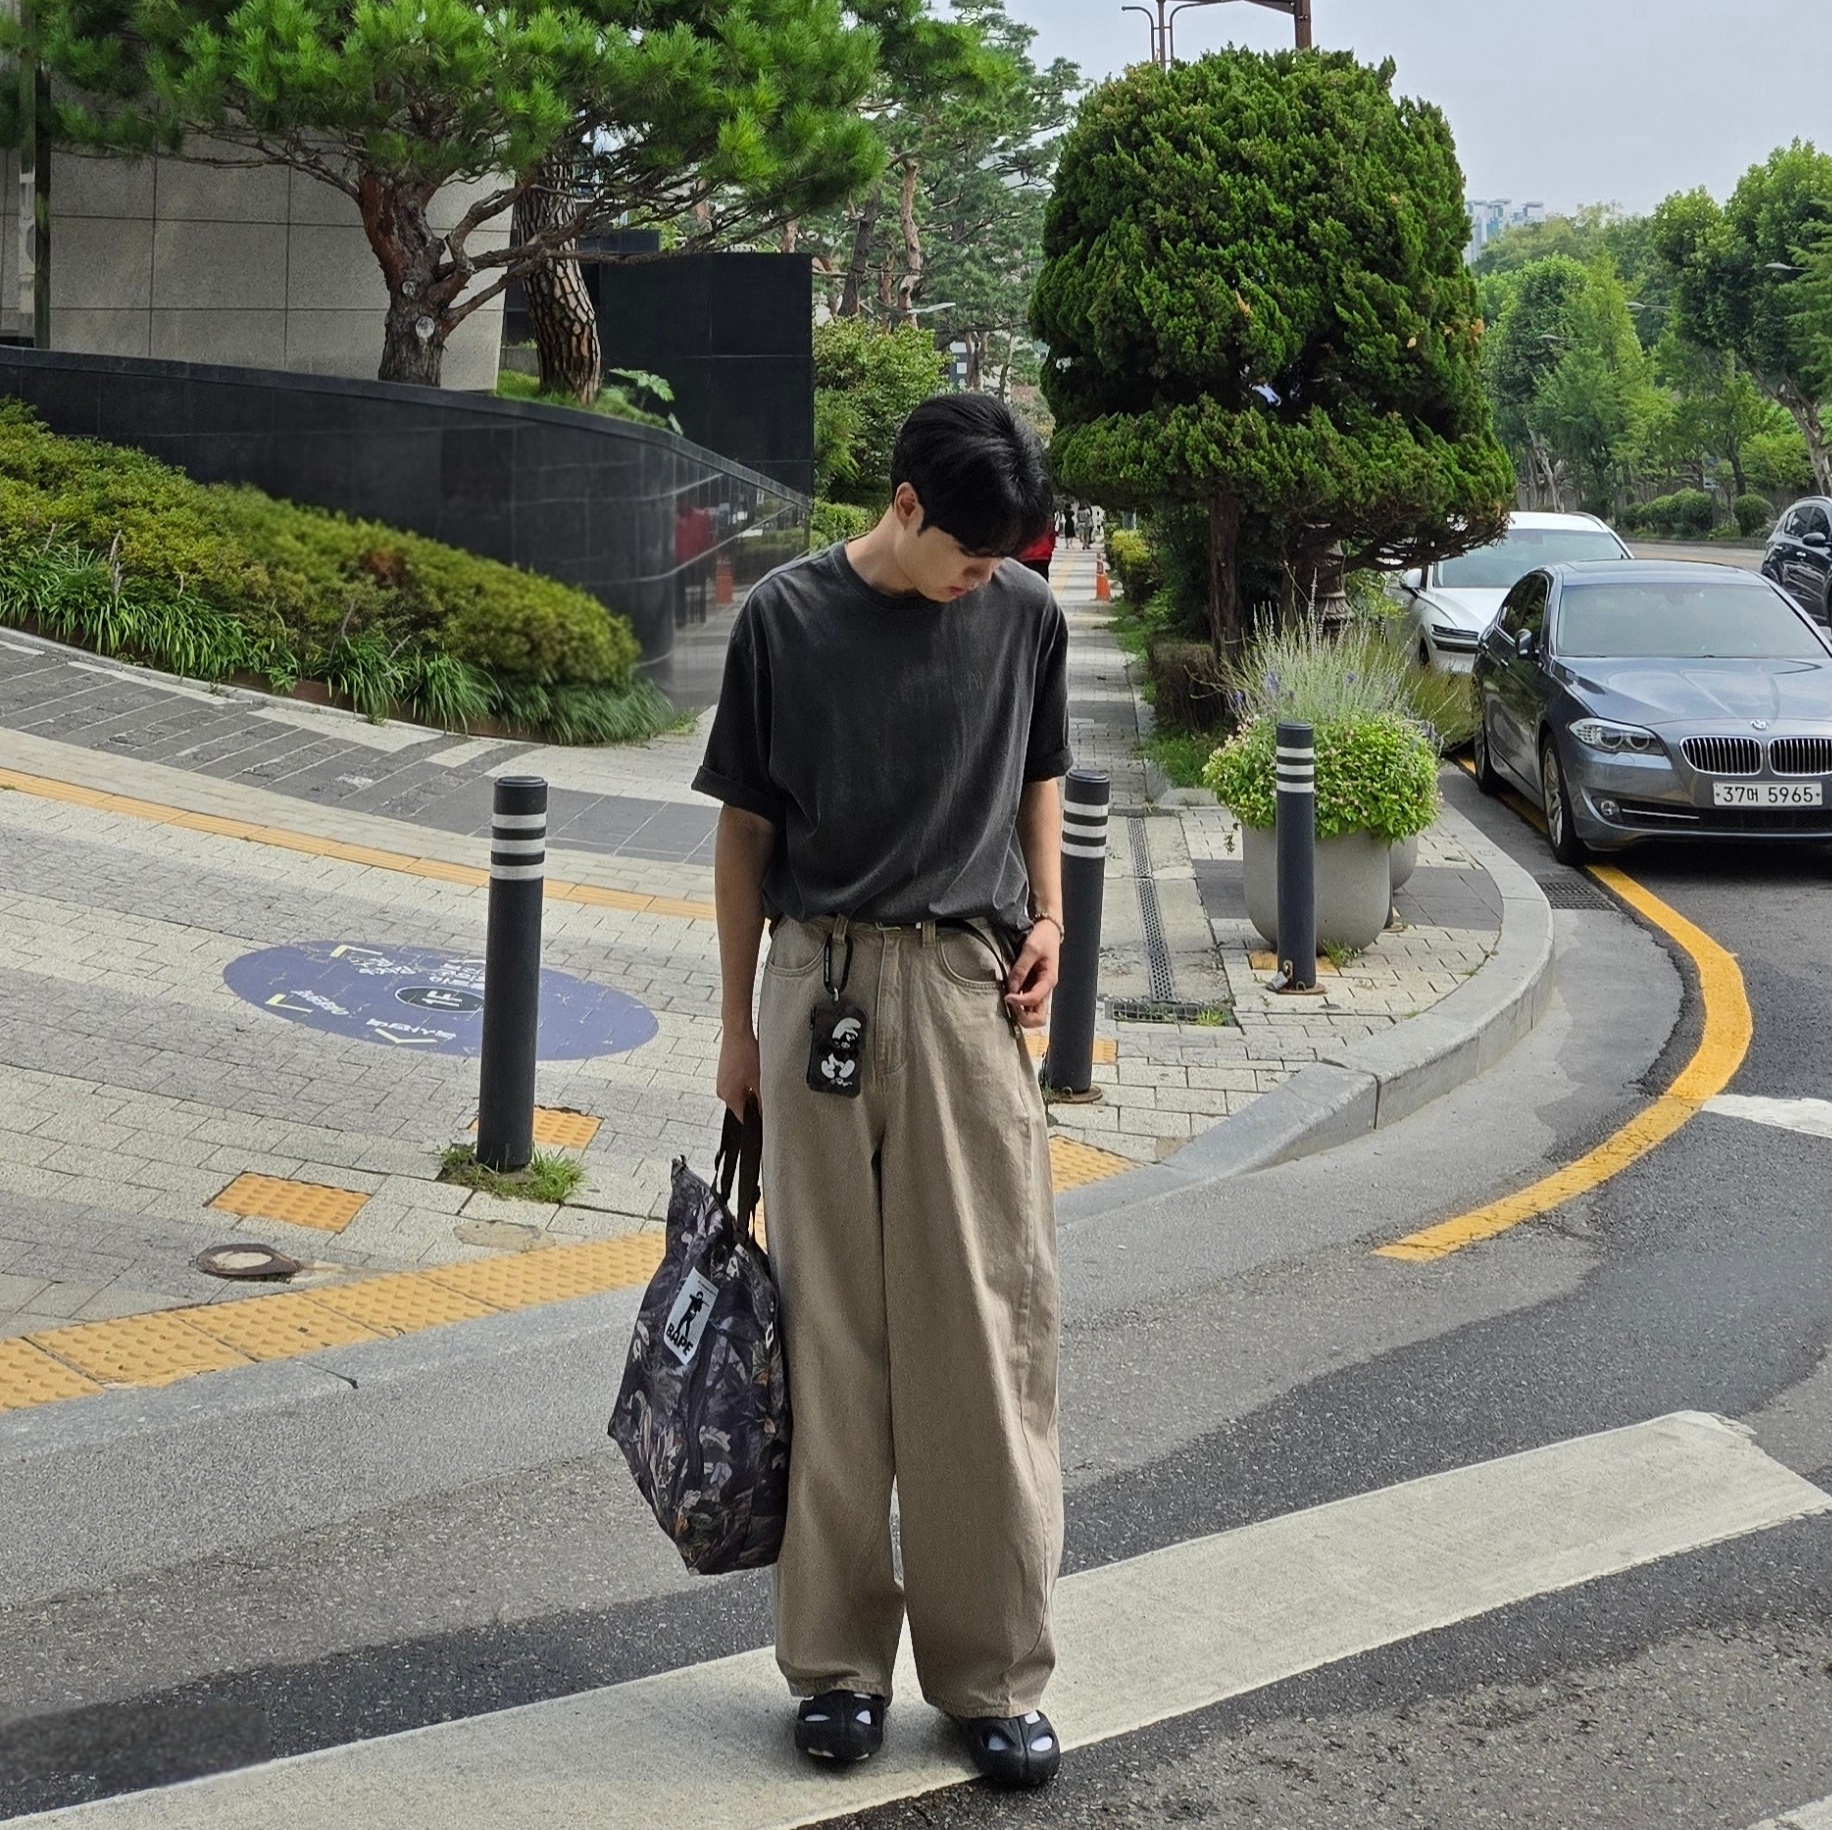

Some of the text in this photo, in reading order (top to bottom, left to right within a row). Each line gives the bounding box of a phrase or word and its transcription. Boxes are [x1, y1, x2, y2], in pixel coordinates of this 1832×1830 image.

[1723, 786, 1813, 803] 37머 5965
[667, 1323, 694, 1356] BAPE
